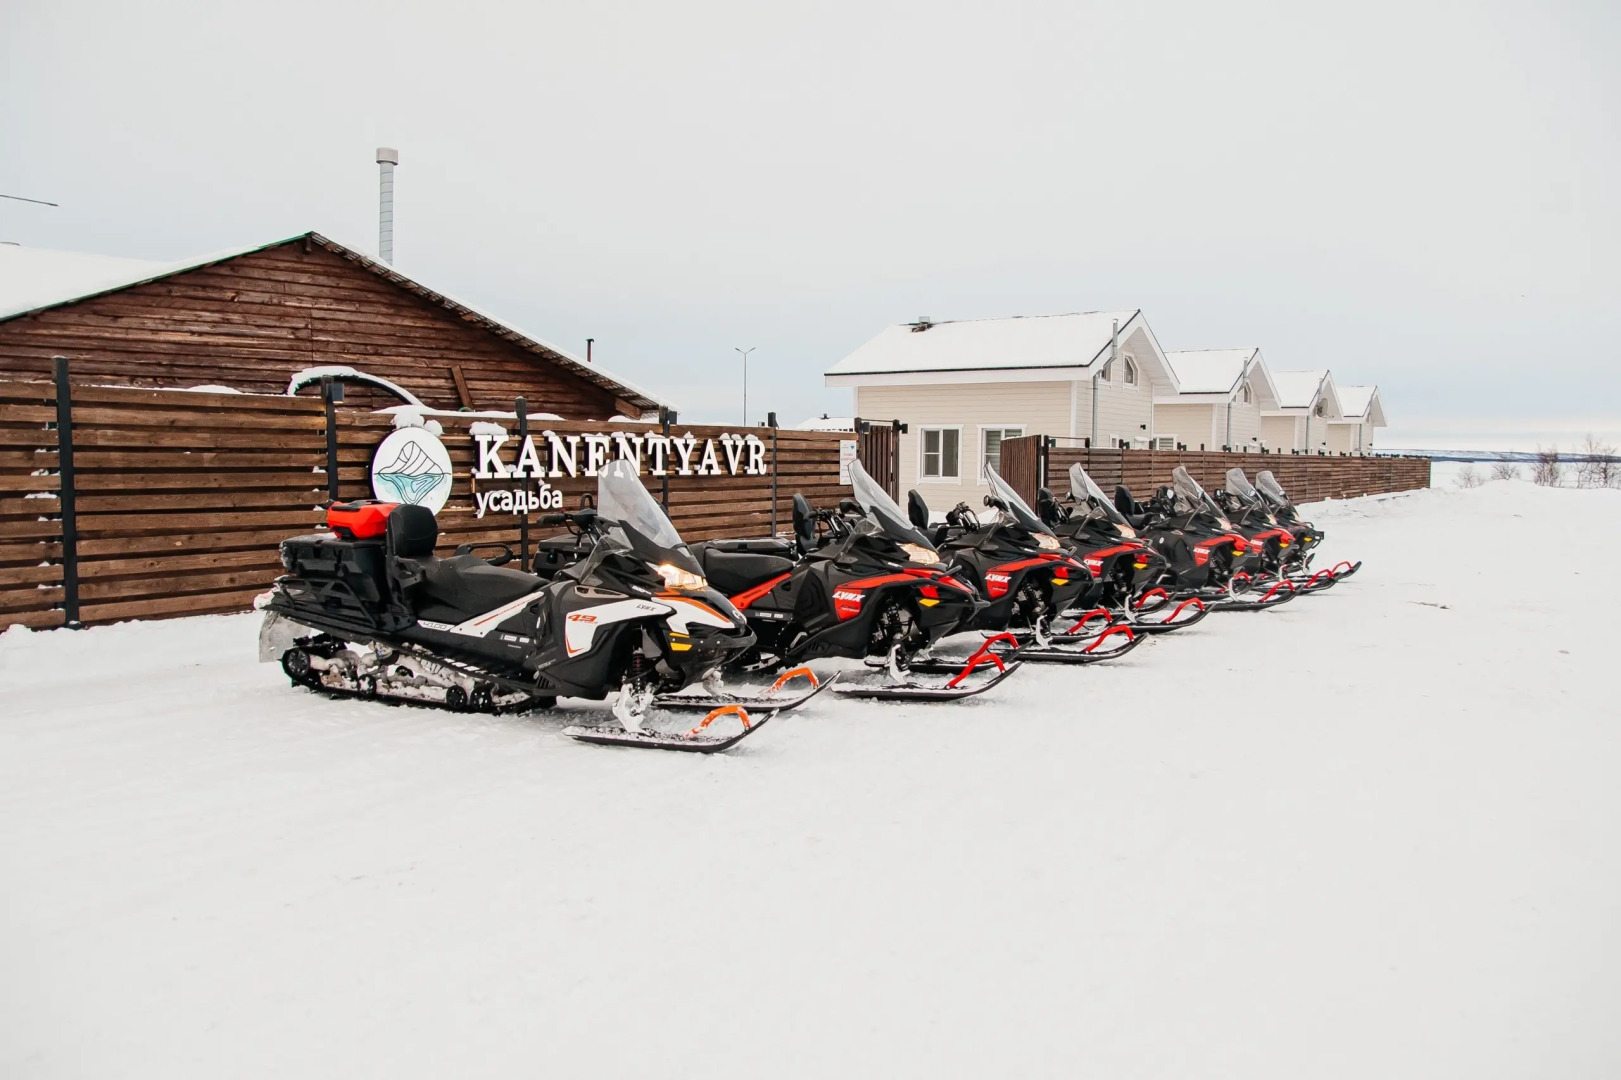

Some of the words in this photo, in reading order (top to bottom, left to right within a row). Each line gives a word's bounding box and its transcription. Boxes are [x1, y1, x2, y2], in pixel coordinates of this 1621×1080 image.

[474, 435, 767, 478] KANENTYAVR
[476, 485, 563, 518] усадьба
[984, 573, 1012, 583] LYNX
[832, 590, 866, 603] LYNX
[636, 603, 656, 612] LYNX
[567, 614, 597, 622] 49
